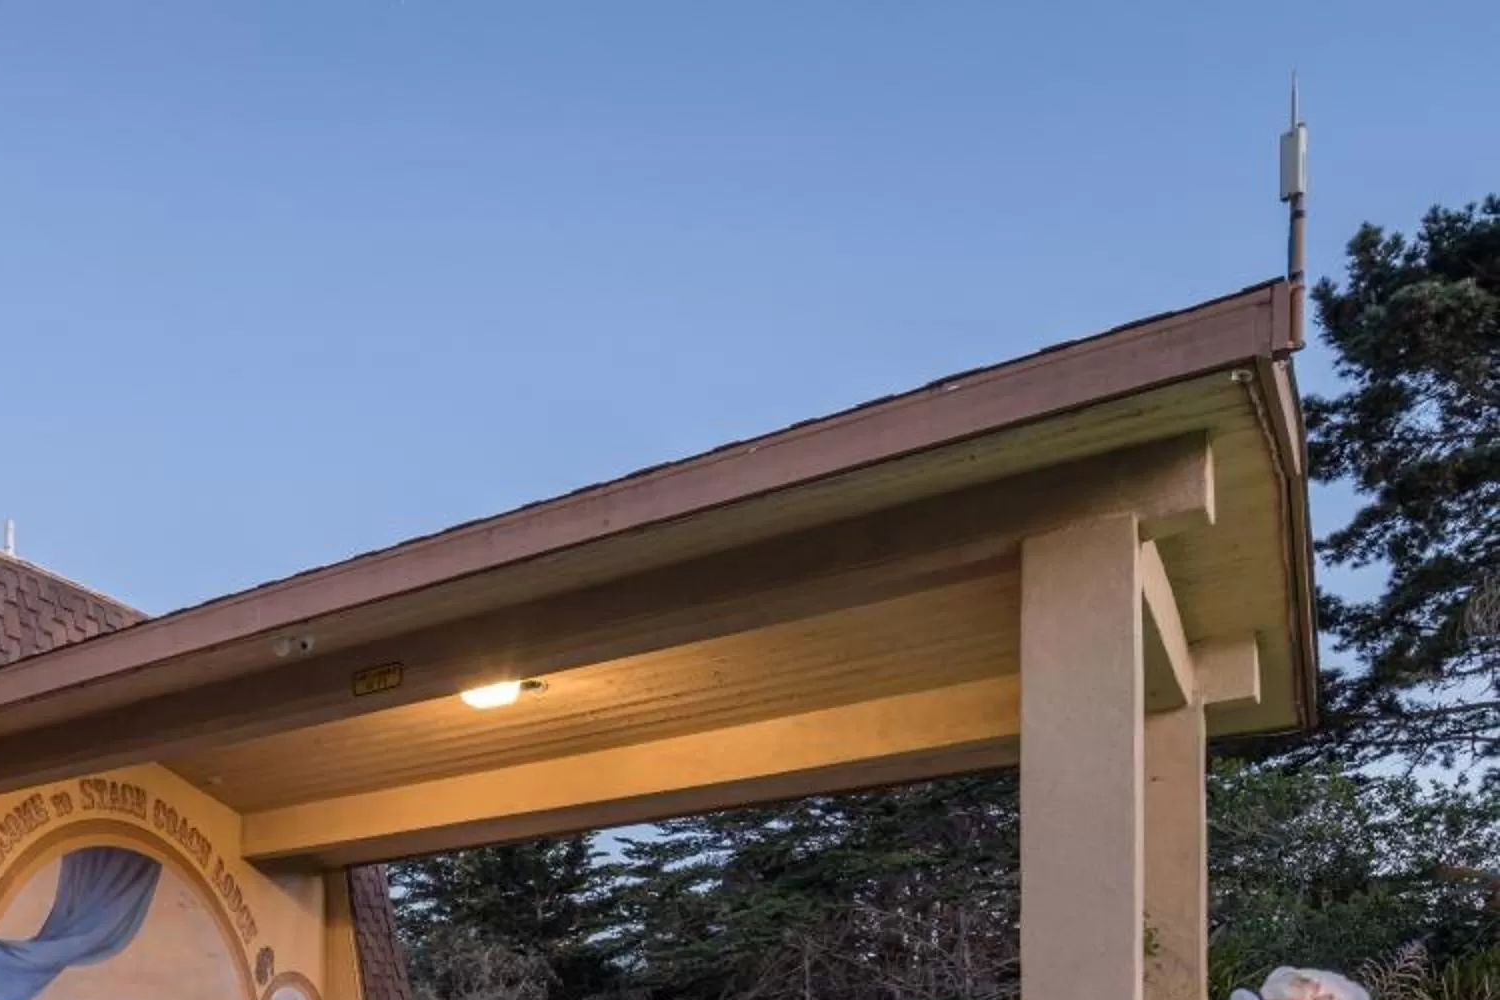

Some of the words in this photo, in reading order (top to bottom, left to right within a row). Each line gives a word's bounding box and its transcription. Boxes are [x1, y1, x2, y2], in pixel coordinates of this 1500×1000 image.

[51, 792, 73, 817] TO
[80, 779, 147, 820] STAGE
[153, 799, 212, 870] COACH
[212, 855, 258, 944] LODGE
